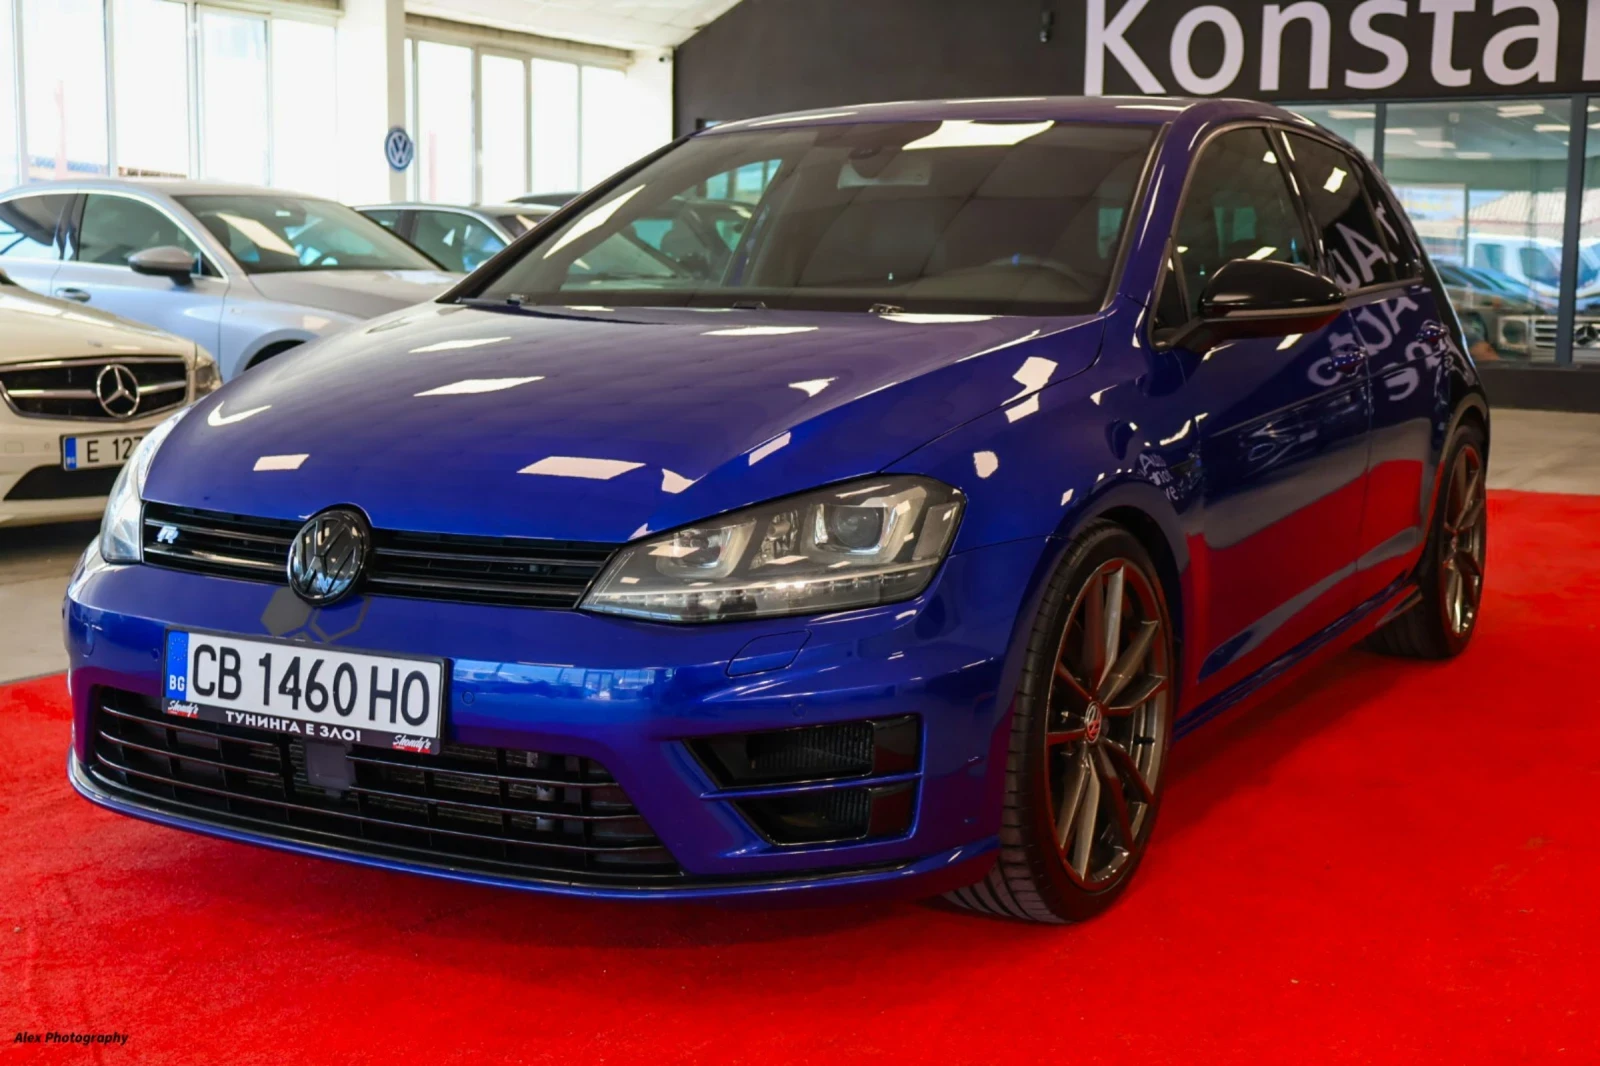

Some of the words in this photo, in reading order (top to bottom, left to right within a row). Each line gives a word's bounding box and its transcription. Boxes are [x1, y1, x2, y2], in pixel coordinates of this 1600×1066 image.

[1084, 0, 1600, 96] Konsta
[87, 439, 99, 463] E
[169, 674, 186, 692] BG
[192, 643, 242, 701] CB
[258, 652, 358, 717] 1460
[368, 664, 430, 727] HO
[225, 710, 300, 734] ТУНИНГА
[306, 723, 315, 736] Е
[319, 726, 362, 742] ЗЛО!
